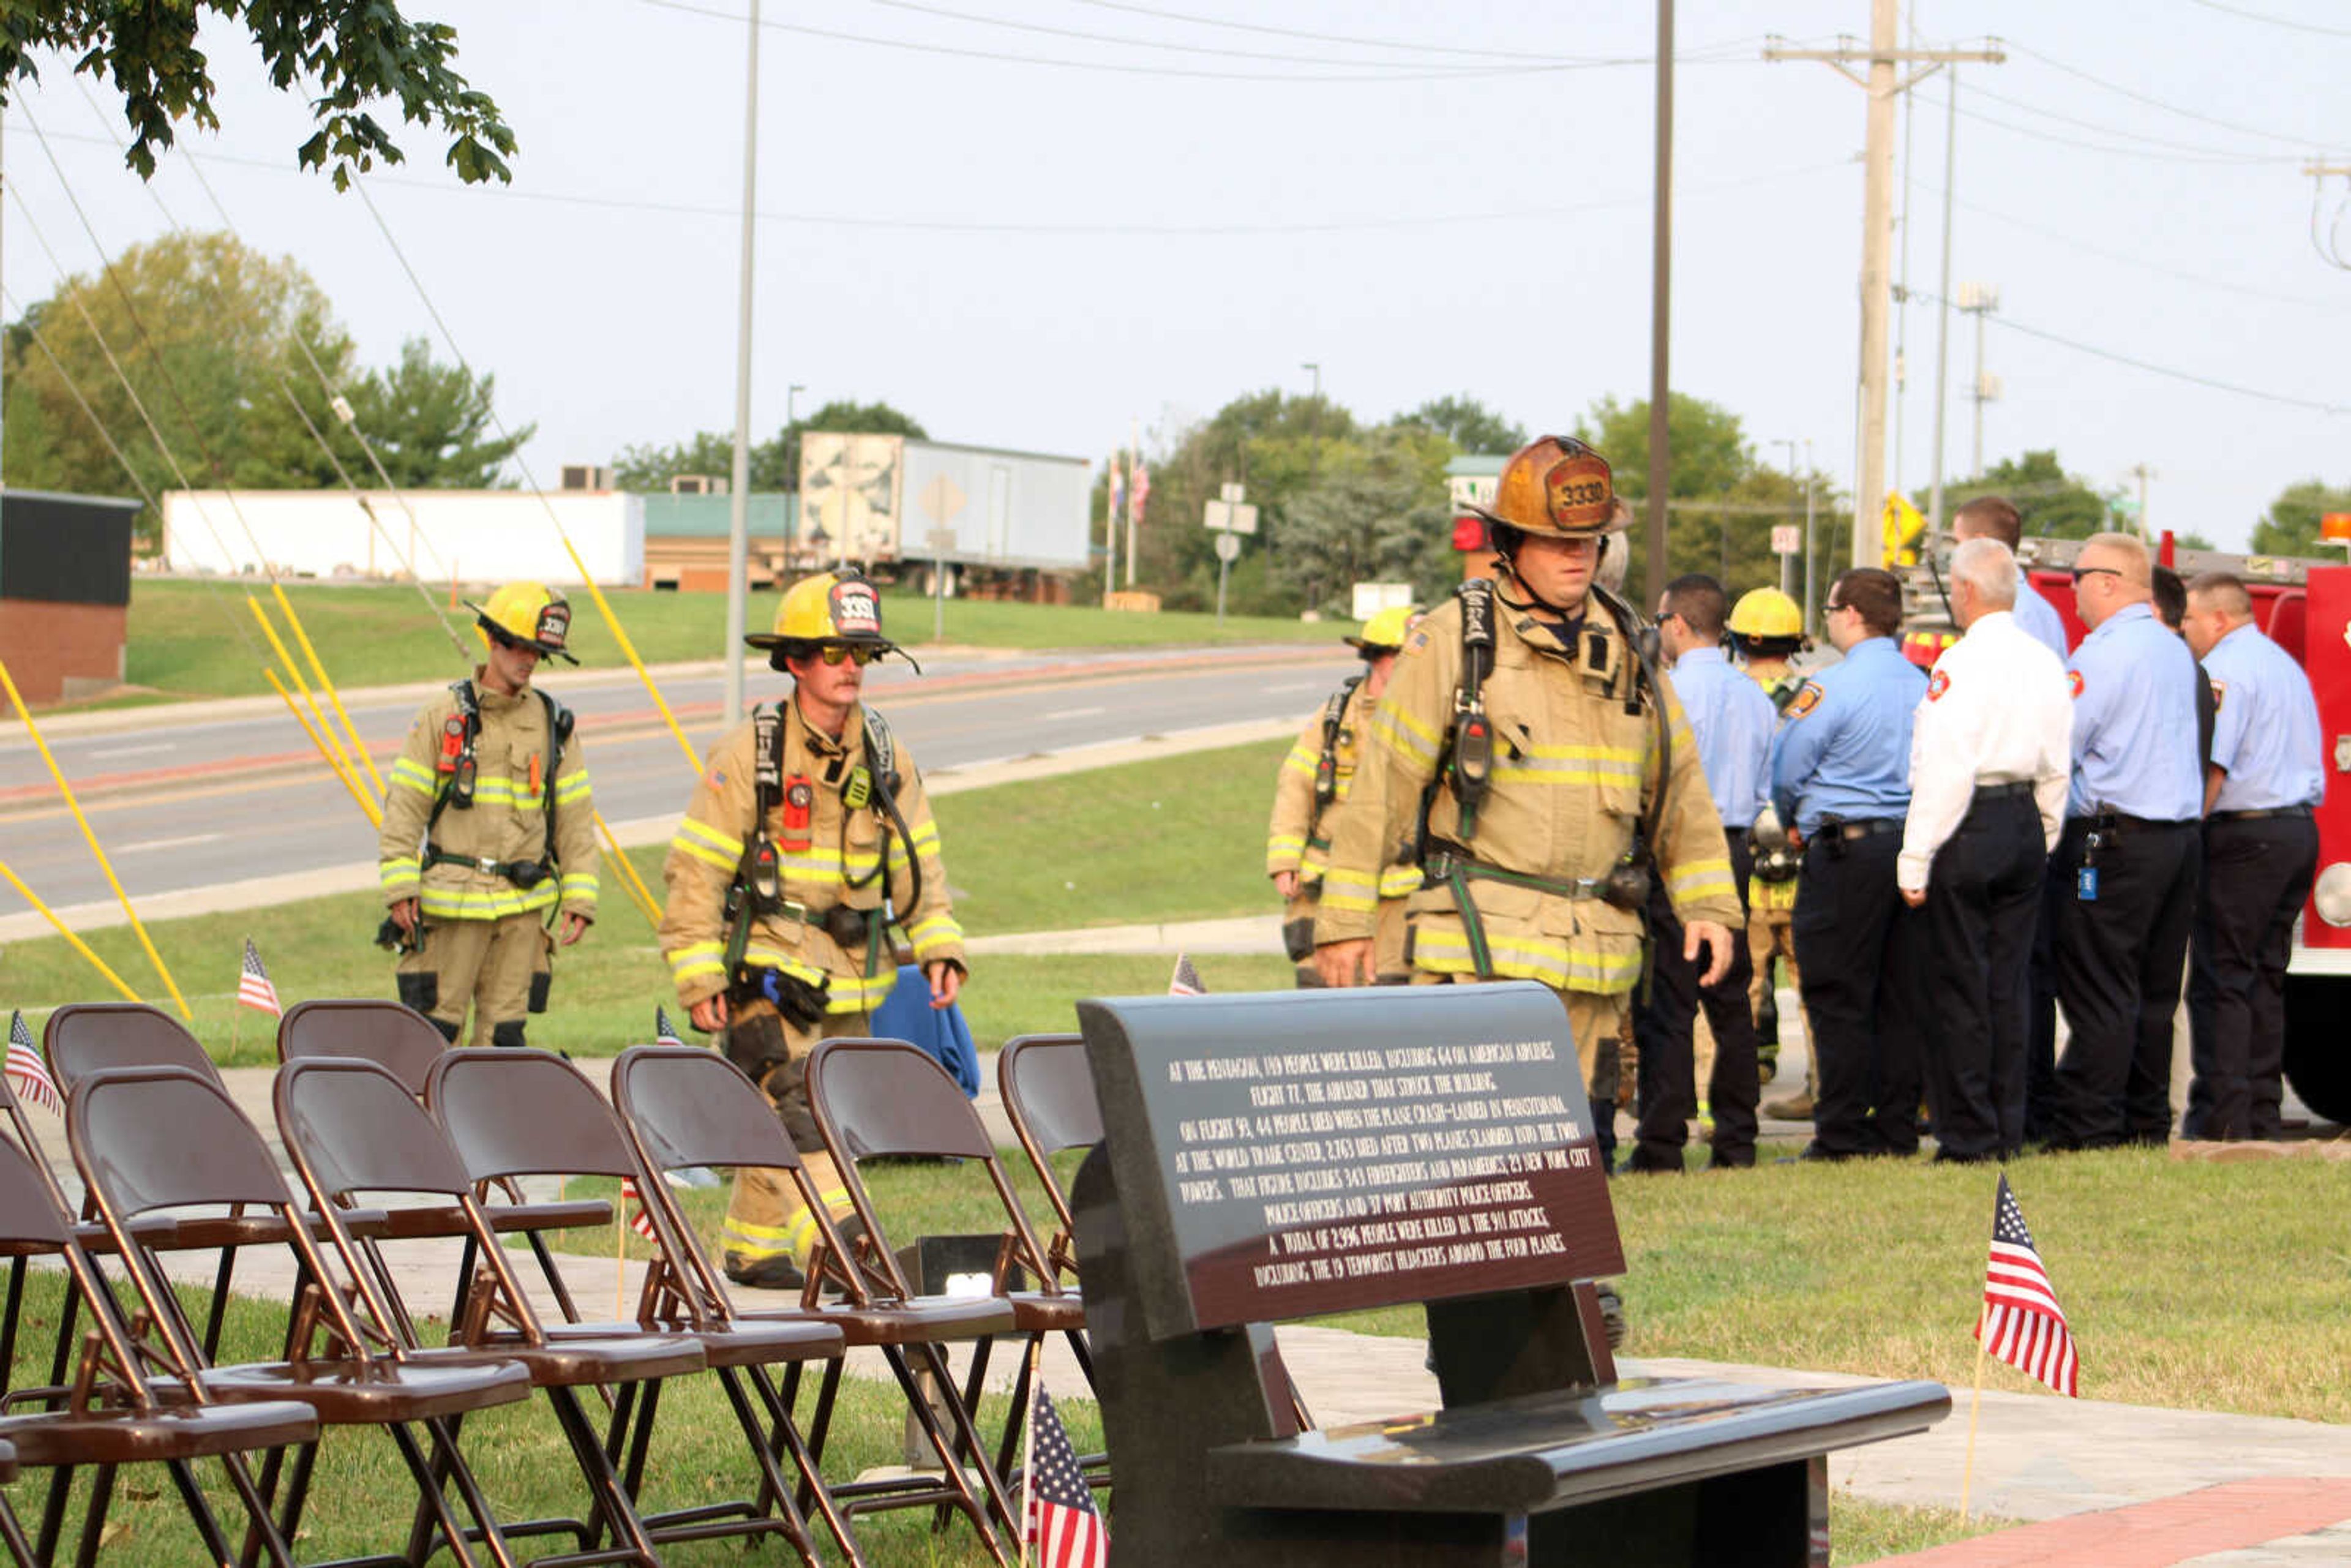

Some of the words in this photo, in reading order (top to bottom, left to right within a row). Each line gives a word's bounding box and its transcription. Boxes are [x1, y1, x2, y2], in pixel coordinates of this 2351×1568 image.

[1561, 481, 1605, 507] 3330
[1169, 1061, 1182, 1081] AT
[1183, 1060, 1206, 1080] THE
[1283, 1054, 1321, 1074] PEOPLE
[1319, 1052, 1349, 1071] WERE
[1385, 1048, 1436, 1067] INCLUDING
[1438, 1046, 1452, 1065] 64
[1452, 1046, 1468, 1064] ON
[1469, 1044, 1513, 1063] AMERICAN
[1516, 1041, 1554, 1060] AIRLINES
[1250, 1085, 1284, 1105] FLIGHT
[1303, 1082, 1325, 1102] THE
[1327, 1080, 1369, 1100] AIRLINER
[1370, 1078, 1395, 1097] THAT
[1396, 1076, 1433, 1096] STRUCK
[1433, 1075, 1453, 1093] THE
[1180, 1121, 1198, 1141] ON
[1198, 1119, 1234, 1139] FLIGHT
[1256, 1117, 1272, 1135] 44
[1272, 1113, 1310, 1134] PEOPLE
[1310, 1111, 1333, 1131] DIED
[1333, 1109, 1363, 1128] WHEN
[1362, 1108, 1382, 1127] THE
[1381, 1106, 1413, 1125] PLANE
[1488, 1100, 1501, 1117] IN
[1176, 1152, 1188, 1172] AT
[1190, 1150, 1213, 1171] THE
[1212, 1148, 1249, 1168] WORLD
[1250, 1144, 1284, 1165] TRADE
[1354, 1137, 1379, 1157] DIED
[1381, 1135, 1409, 1154] AFTER
[1411, 1133, 1433, 1152] TWO
[1434, 1130, 1469, 1150] PLANES
[1469, 1127, 1513, 1147] SLAMMED
[1514, 1125, 1538, 1144] INTO
[1537, 1123, 1557, 1142] THE
[1557, 1122, 1580, 1141] TWIN
[1229, 1177, 1256, 1197] THAT
[1258, 1174, 1294, 1195] FIGURE
[1294, 1169, 1343, 1191] INCLUDES
[1344, 1167, 1366, 1187] 343
[1366, 1162, 1428, 1185] FIREFIGHTERS
[1430, 1160, 1450, 1180] AND
[1507, 1153, 1521, 1172] 23
[1521, 1150, 1542, 1171] NEW
[1543, 1150, 1569, 1168] YORK
[1570, 1149, 1589, 1166] CITY
[1264, 1202, 1301, 1226] POLICE
[1299, 1198, 1344, 1221] OFFICERS
[1346, 1196, 1368, 1216] AND
[1368, 1194, 1381, 1214] 37
[1382, 1191, 1406, 1212] PORT
[1406, 1188, 1458, 1209] AUTHORITY
[1459, 1185, 1491, 1204] POLICE
[1269, 1236, 1278, 1254] A
[1282, 1232, 1316, 1252] TOTAL
[1316, 1229, 1329, 1248] OF
[1331, 1226, 1360, 1248] 2,996
[1360, 1223, 1397, 1244] PEOPLE
[1396, 1220, 1423, 1239] WERE
[1423, 1217, 1457, 1237] KILLED
[1458, 1215, 1471, 1234] IN
[1472, 1213, 1491, 1231] THE
[1254, 1262, 1309, 1285] INCLUDING
[1311, 1259, 1331, 1278] THE
[1332, 1258, 1343, 1277] 19
[1345, 1253, 1393, 1274] TERRORIST
[1395, 1247, 1446, 1269] HIJACKERS
[1449, 1243, 1484, 1262] ABOARD
[1485, 1240, 1504, 1258] THE
[1504, 1238, 1527, 1256] FOUR
